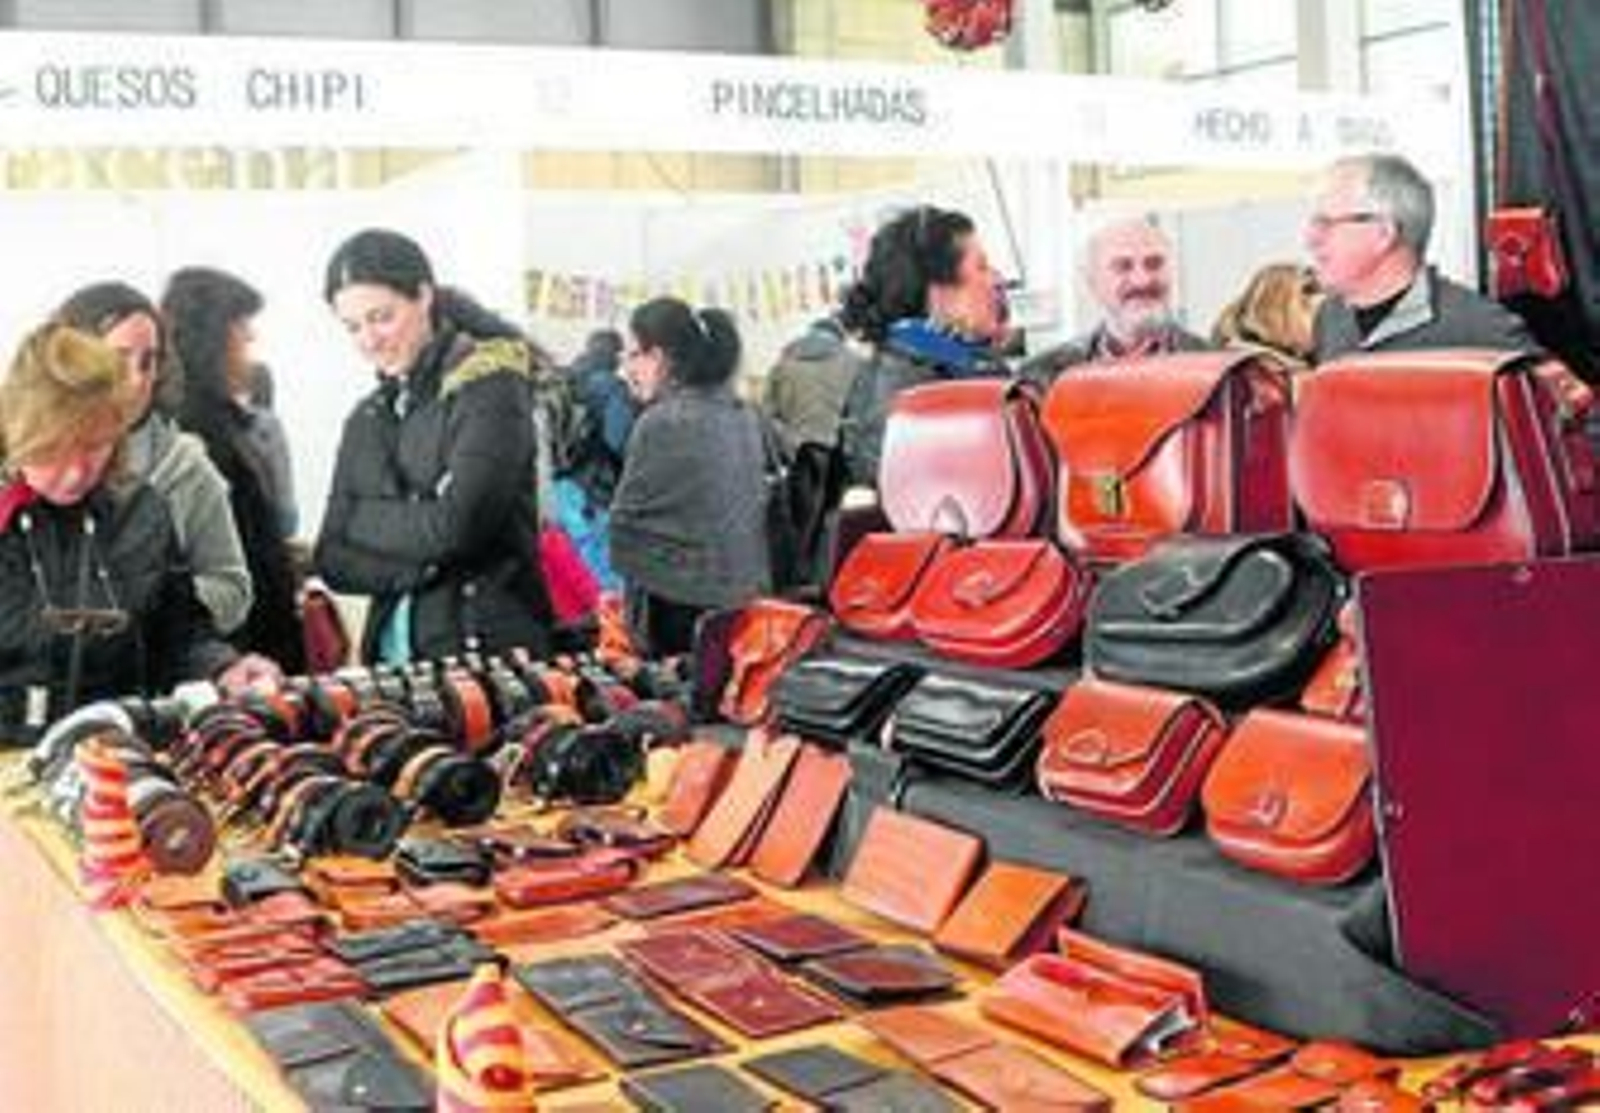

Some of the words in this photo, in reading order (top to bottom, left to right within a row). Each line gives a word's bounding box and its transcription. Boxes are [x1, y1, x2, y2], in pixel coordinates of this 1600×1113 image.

[36, 65, 197, 109] QUESOS
[246, 68, 364, 111] CHIPI
[711, 81, 926, 126] PINCELHADAS
